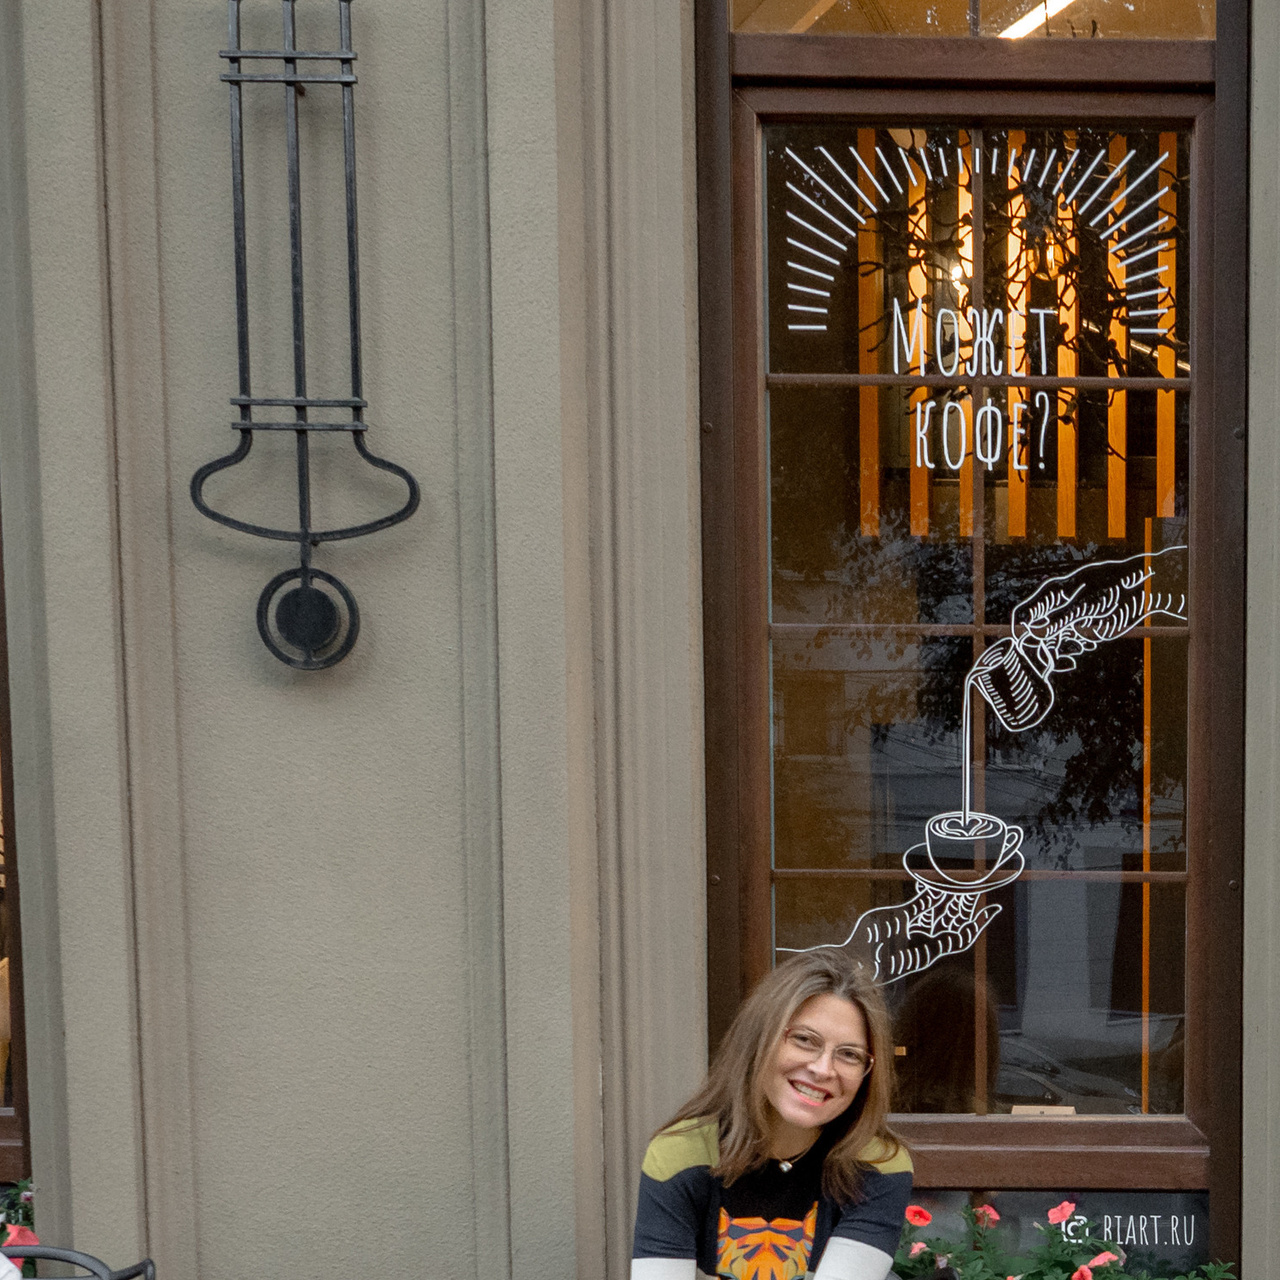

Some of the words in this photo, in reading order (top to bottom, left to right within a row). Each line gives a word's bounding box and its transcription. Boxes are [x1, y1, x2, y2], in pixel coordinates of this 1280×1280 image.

[892, 297, 1058, 377] МОЖЕТ
[916, 391, 1049, 471] КОФЕ?
[1103, 1214, 1195, 1246] BIART.RU
